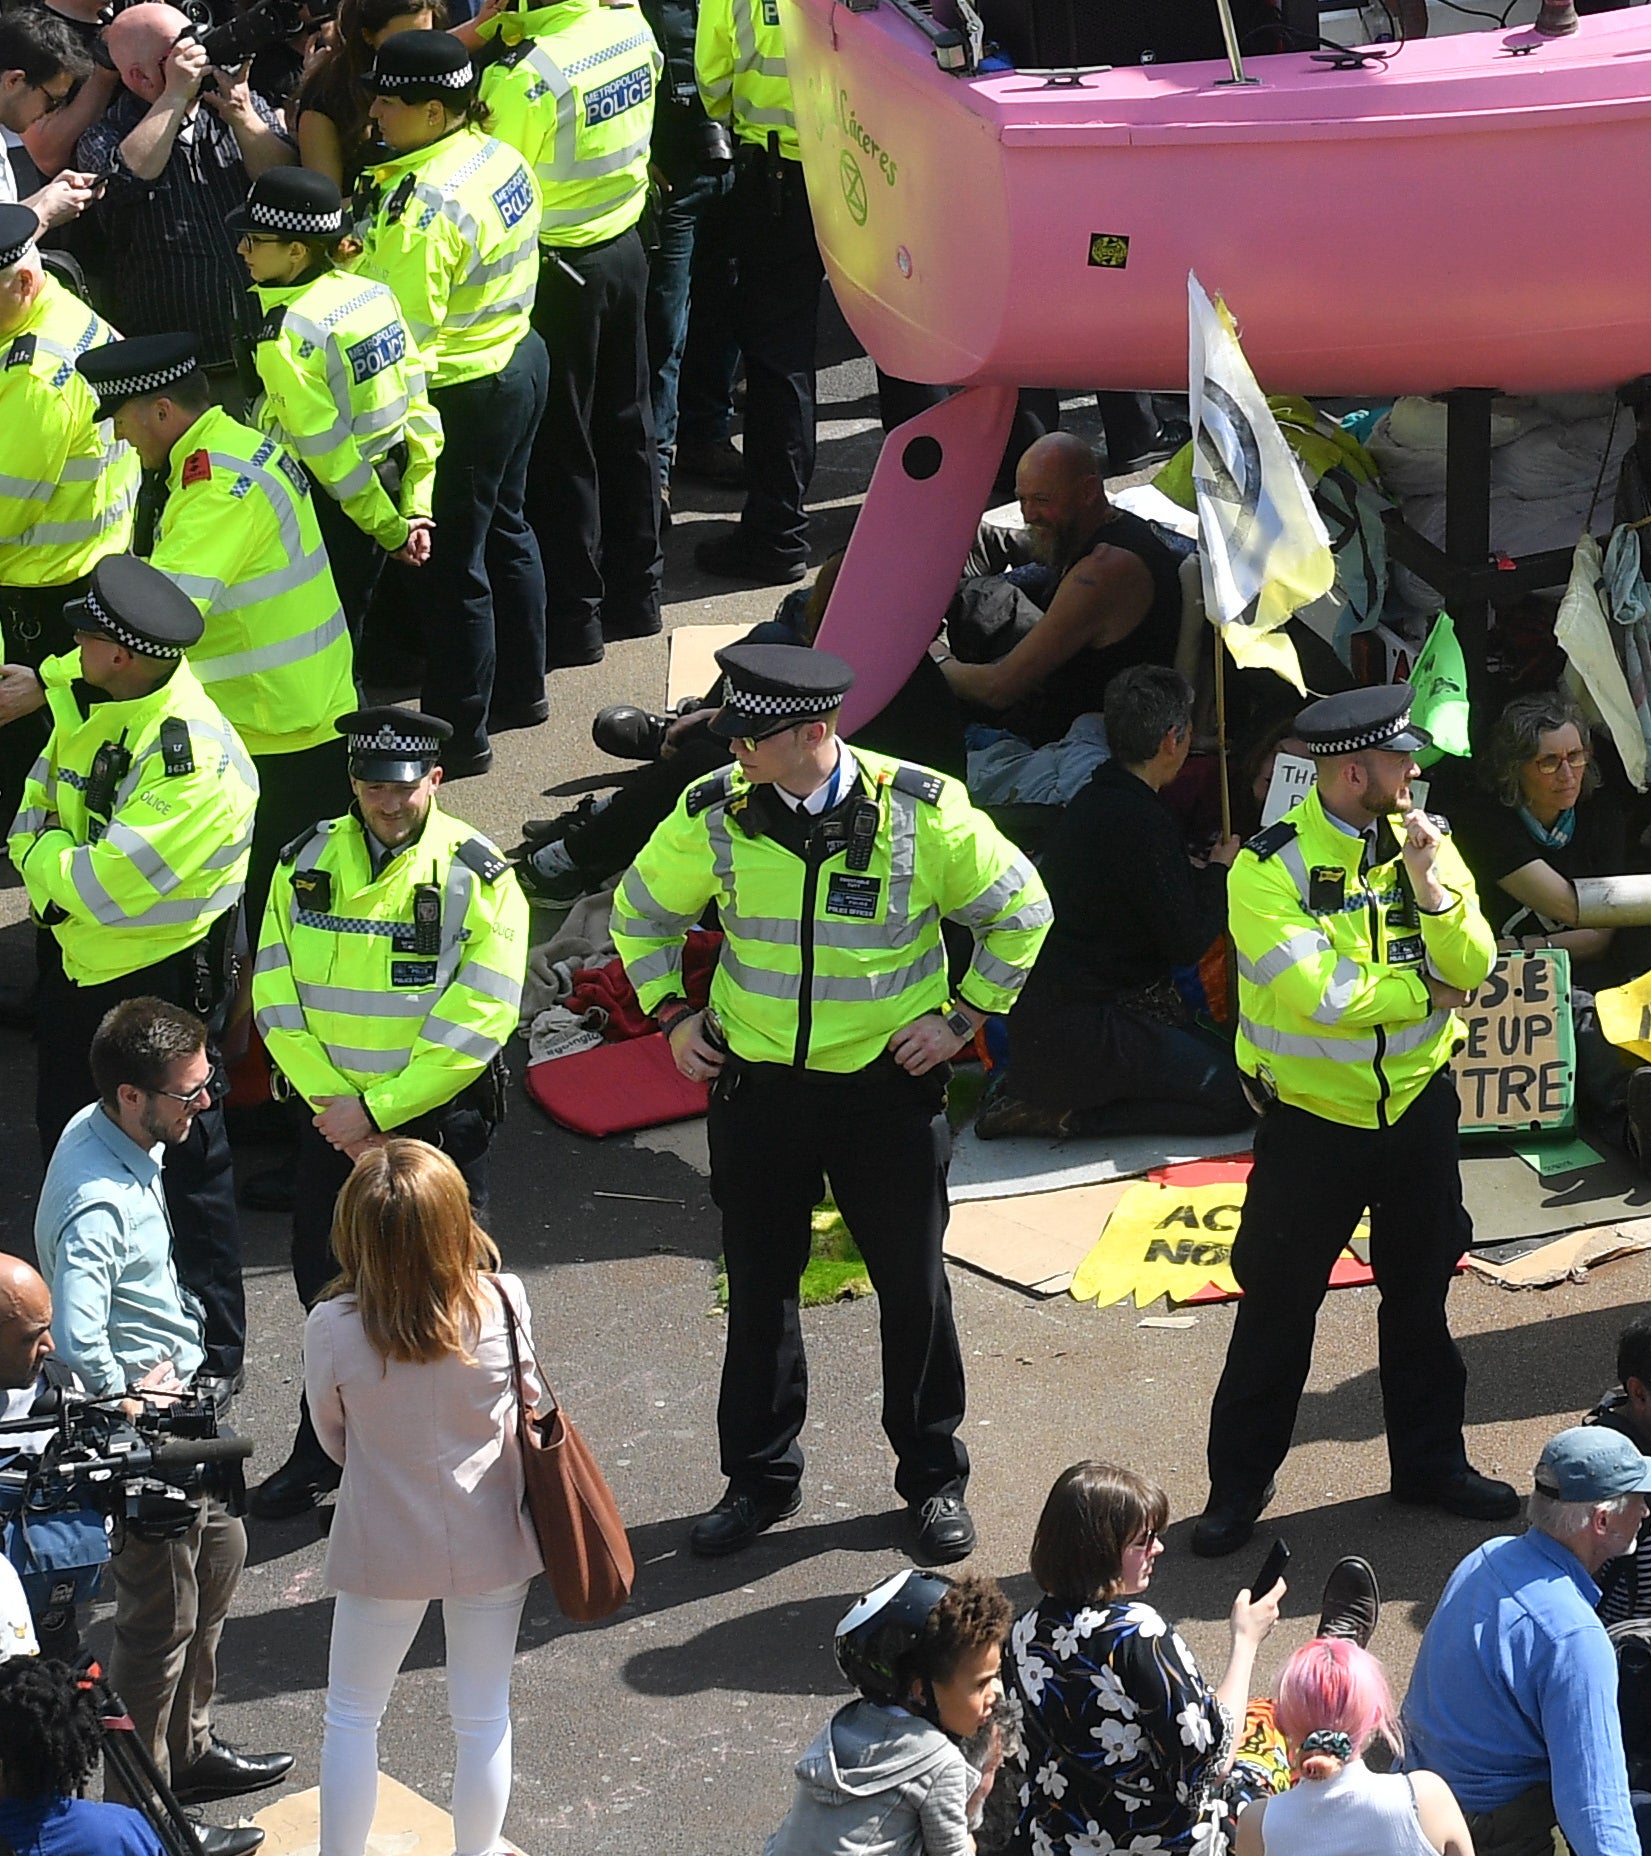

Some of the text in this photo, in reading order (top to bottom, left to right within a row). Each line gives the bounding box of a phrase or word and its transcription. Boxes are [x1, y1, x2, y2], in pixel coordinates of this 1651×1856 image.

[585, 67, 650, 105] METROPOLITAN
[586, 82, 652, 125] POLICE
[353, 334, 404, 382] POLICE
[140, 790, 172, 816] OLICE
[827, 905, 874, 918] POLICE OFFICER
[492, 921, 516, 942] OLICE
[1462, 958, 1550, 1011] SE
[1497, 1017, 1553, 1056] UP
[1452, 1060, 1570, 1120] TRE
[1154, 1205, 1242, 1232] AC
[1143, 1239, 1231, 1267] NO
